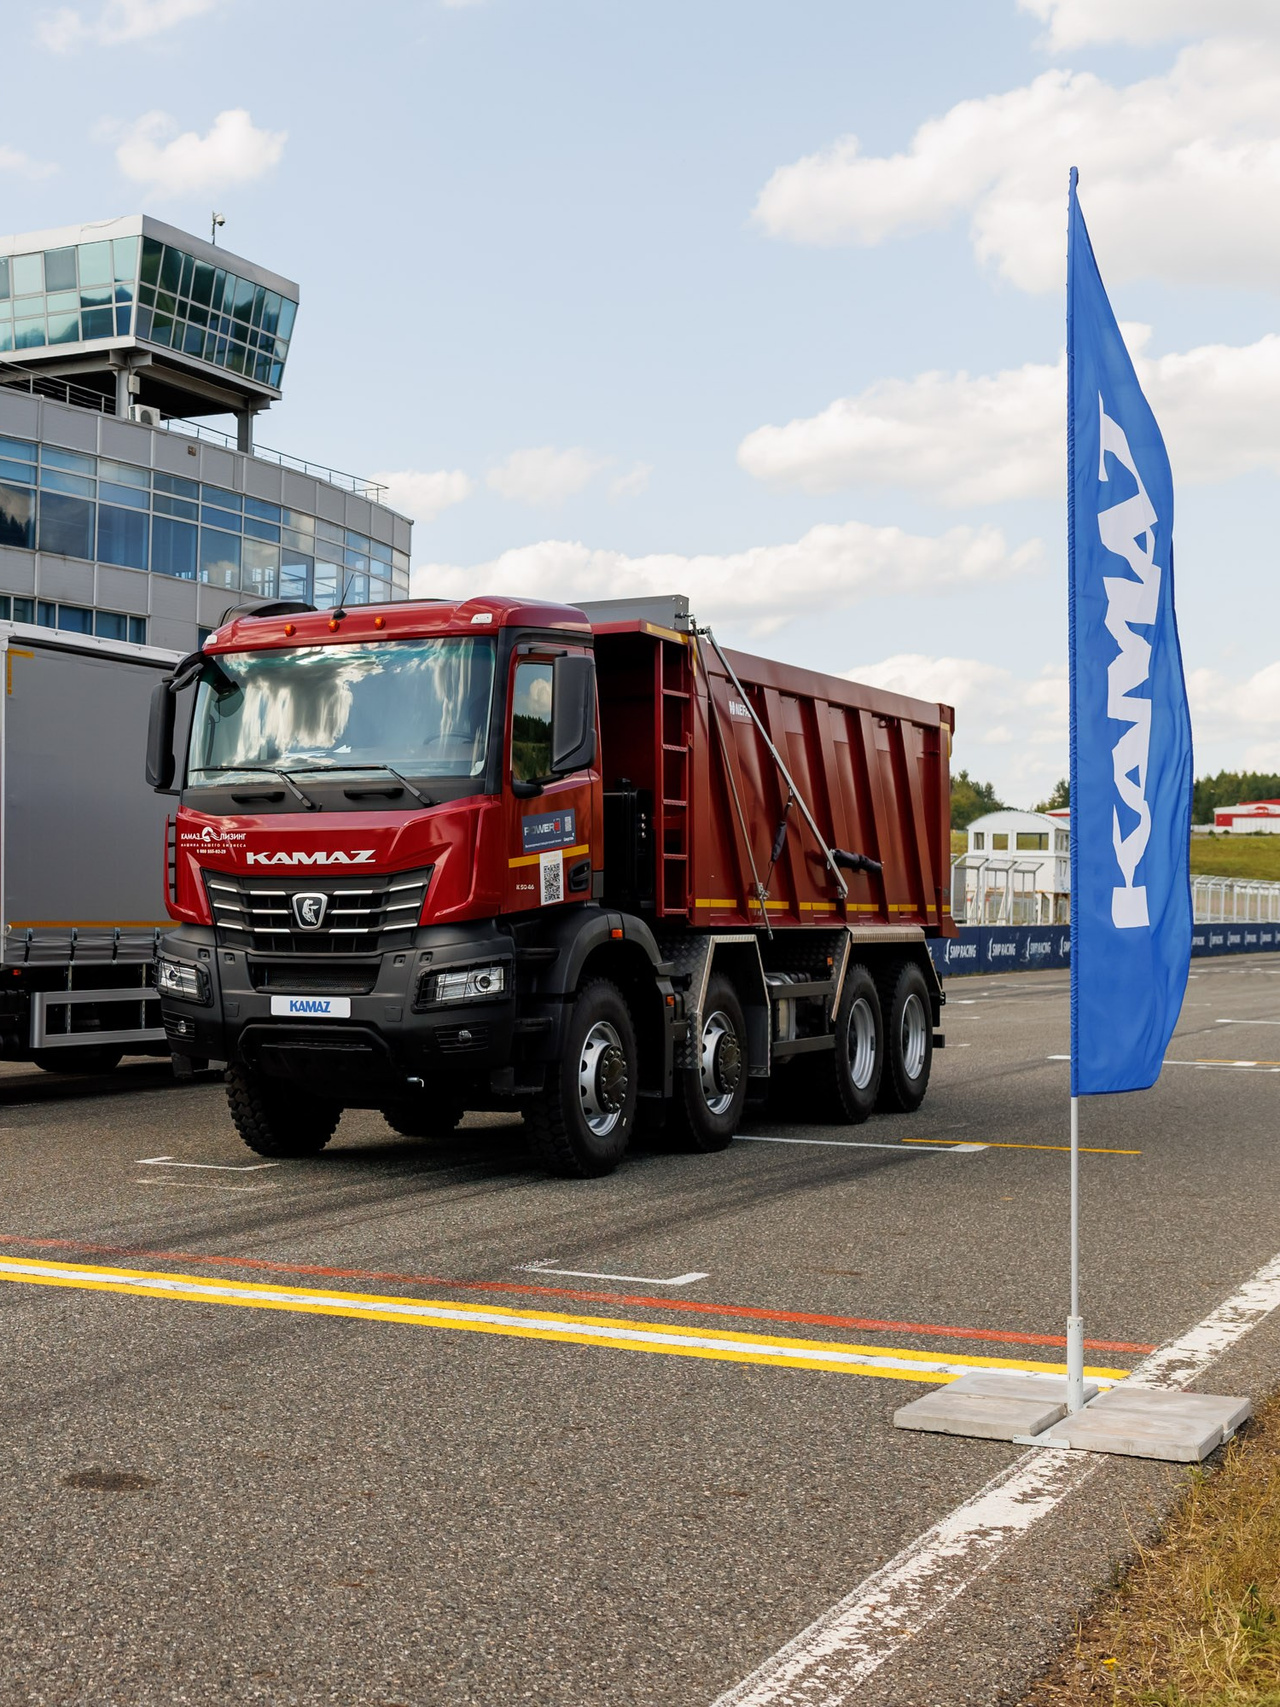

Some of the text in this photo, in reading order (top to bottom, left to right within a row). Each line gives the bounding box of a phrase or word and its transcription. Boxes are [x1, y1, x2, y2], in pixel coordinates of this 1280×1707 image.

[1097, 389, 1162, 929] KAMAZ
[736, 704, 751, 717] NEFA
[246, 850, 376, 865] KAMAZ
[960, 944, 976, 958] RACING
[289, 1000, 331, 1013] KAMAZ
